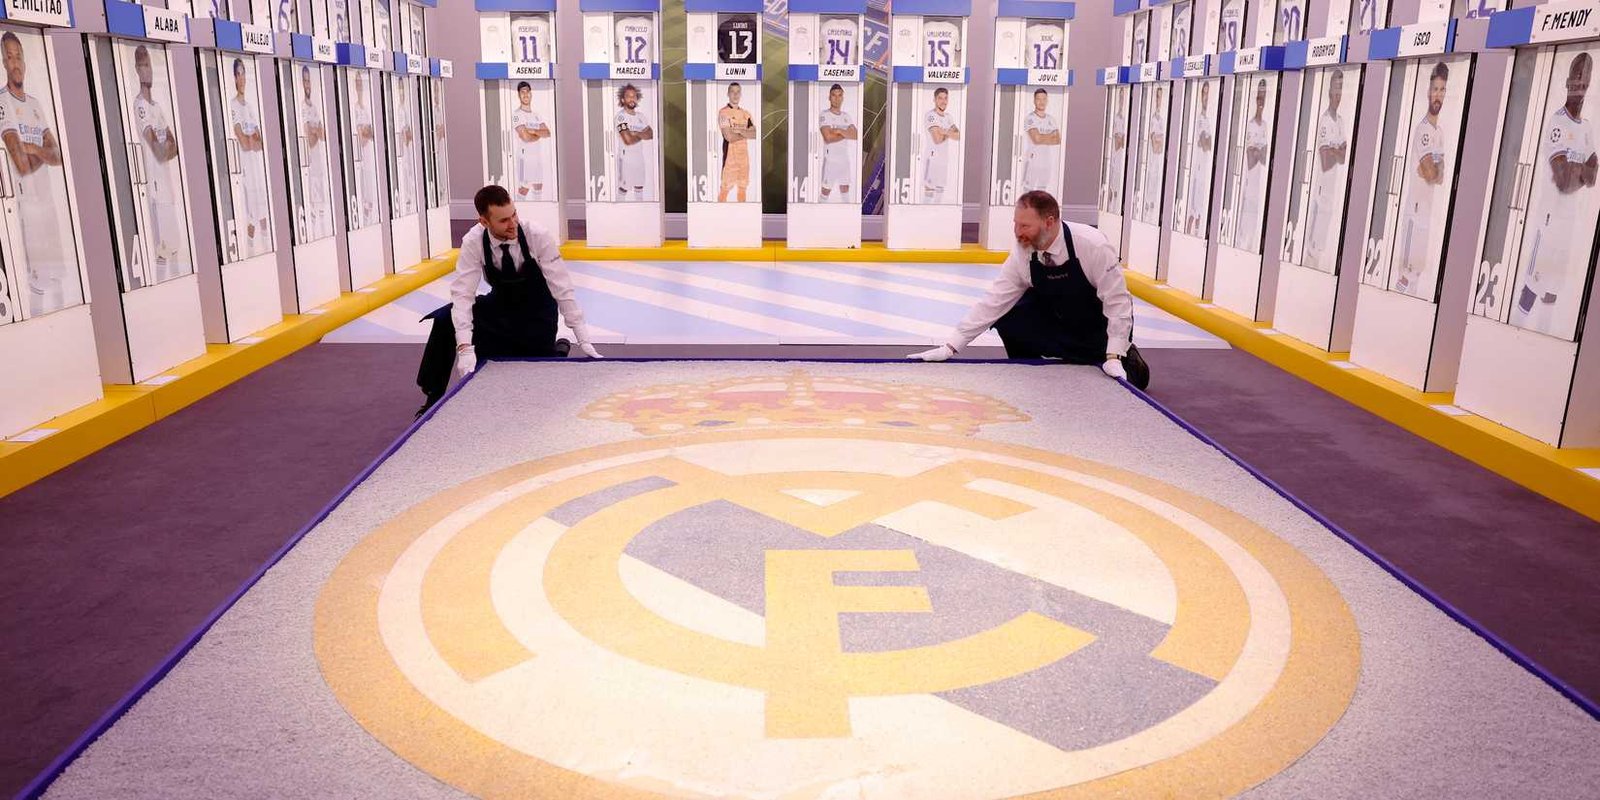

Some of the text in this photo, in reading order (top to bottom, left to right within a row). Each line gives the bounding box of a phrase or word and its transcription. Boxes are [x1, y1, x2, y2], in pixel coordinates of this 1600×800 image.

[154, 16, 179, 33] ALABA
[1541, 8, 1593, 31] F.MENDY
[245, 33, 269, 46] VALLEJO
[519, 36, 541, 62] 11
[625, 36, 647, 63] 12
[729, 31, 752, 59] 13
[827, 39, 850, 65] 14
[928, 40, 950, 67] 15
[1033, 43, 1058, 69] 16
[616, 66, 646, 75] MARCELO
[928, 71, 960, 79] VALVERDE
[1474, 260, 1502, 323] 23
